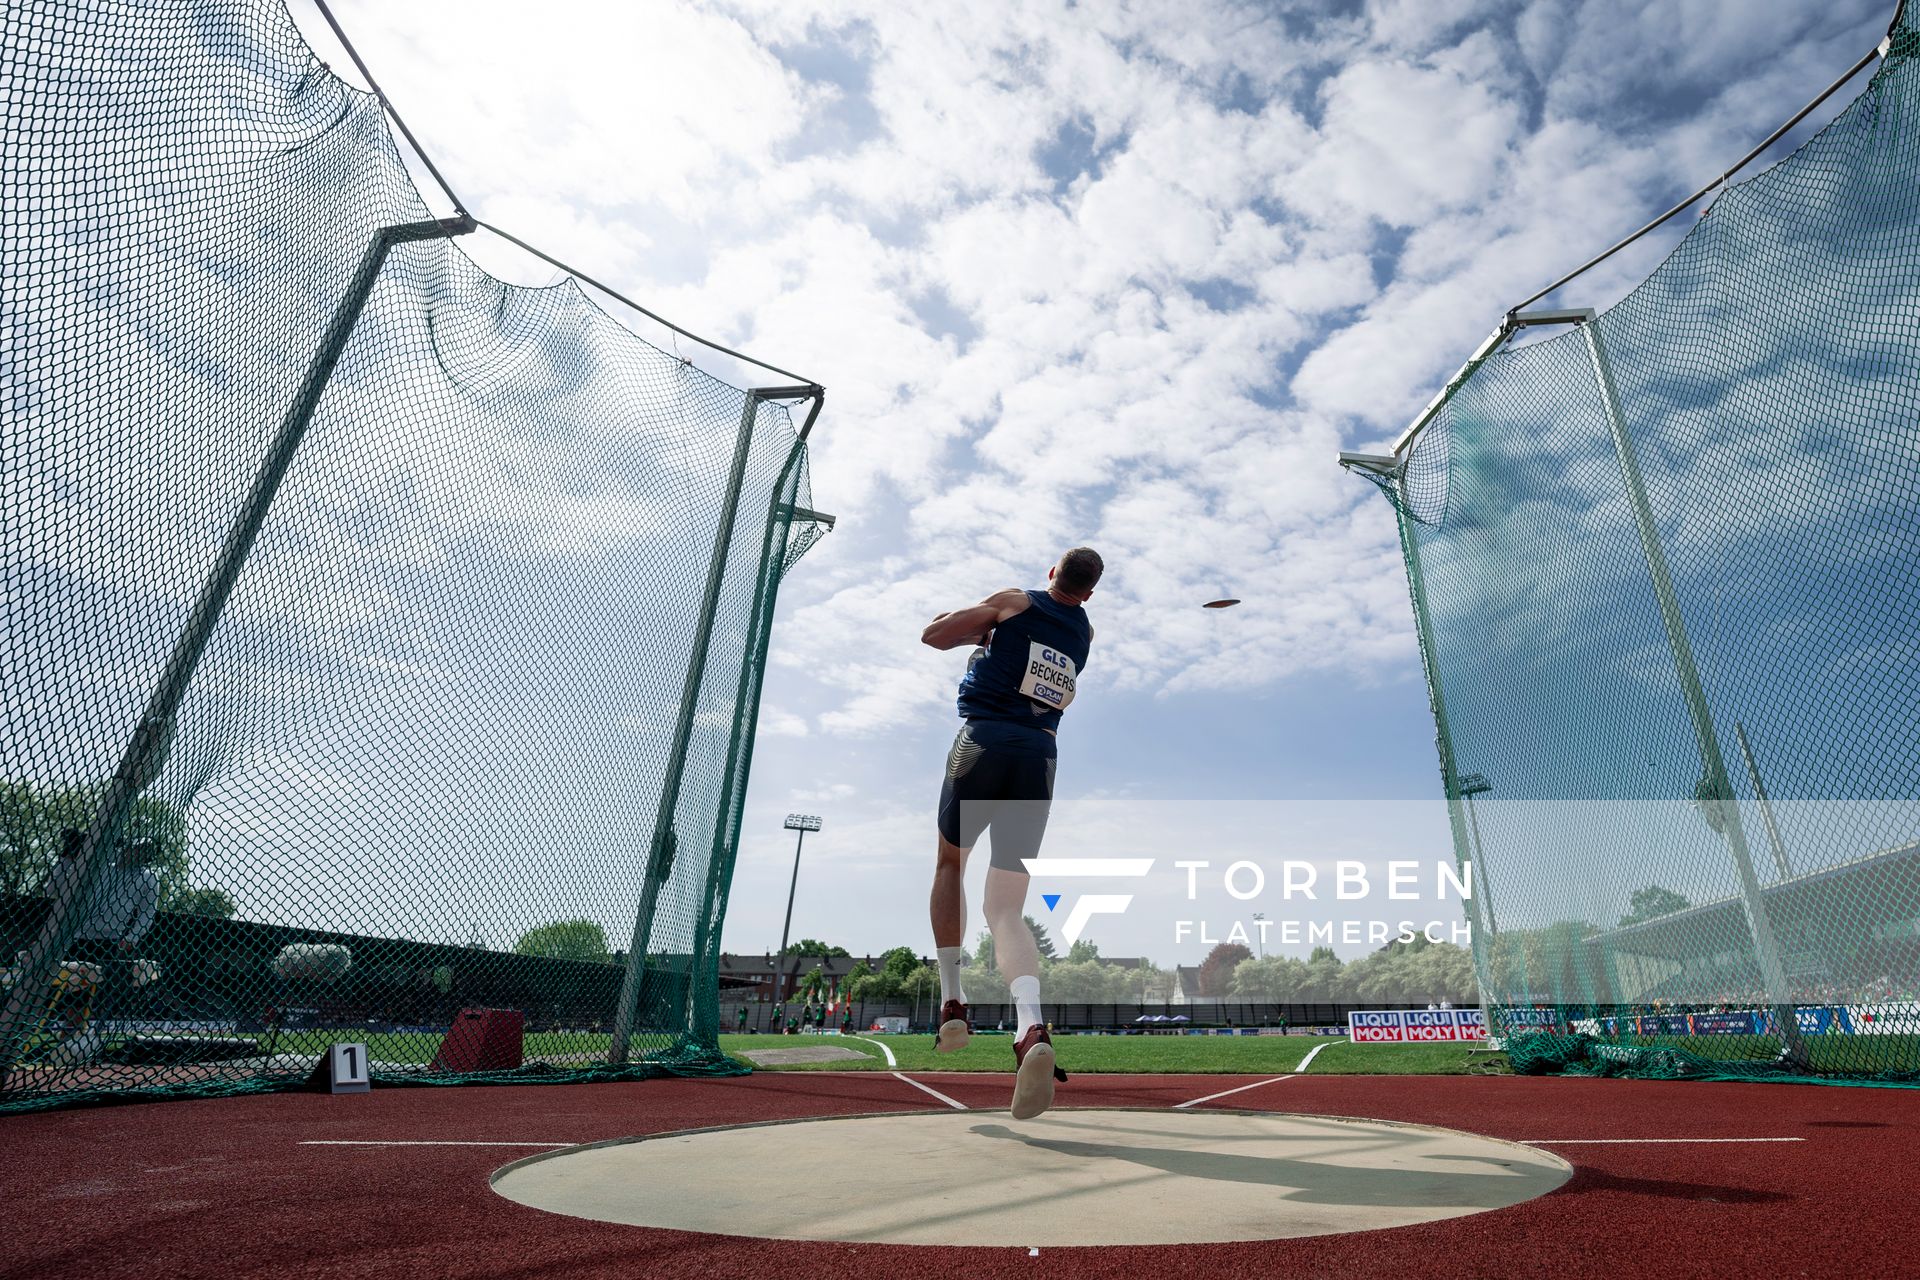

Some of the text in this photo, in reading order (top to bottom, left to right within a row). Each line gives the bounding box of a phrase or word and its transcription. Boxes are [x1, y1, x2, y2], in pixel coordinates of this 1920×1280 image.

[1030, 661, 1075, 693] BECKERS
[1354, 1012, 1399, 1027] LIQUI
[1405, 1012, 1451, 1026] LIQUI
[1355, 1027, 1401, 1041] MOLY
[1408, 1026, 1454, 1041] MOLY
[342, 1046, 358, 1079] 1
